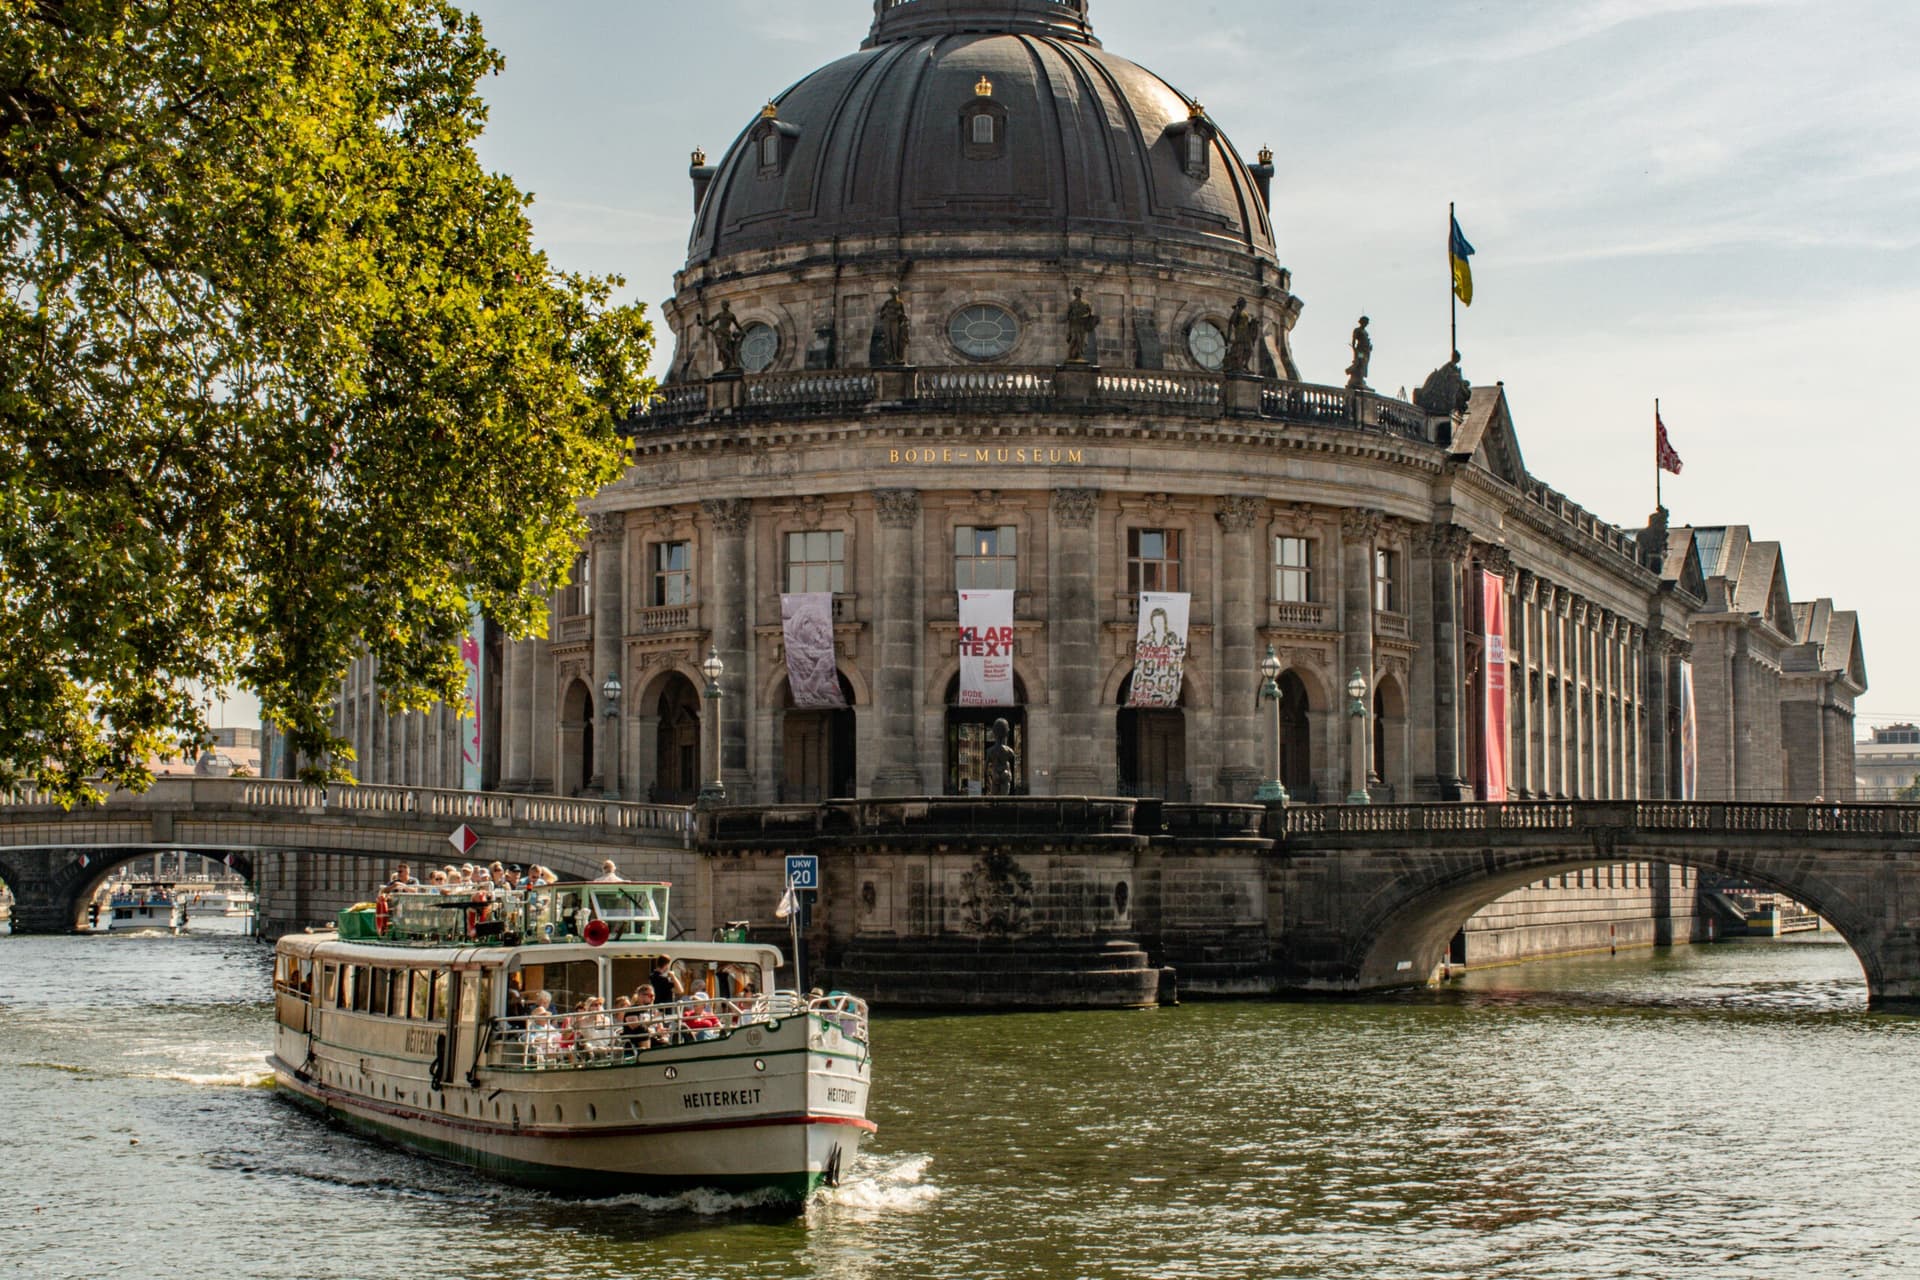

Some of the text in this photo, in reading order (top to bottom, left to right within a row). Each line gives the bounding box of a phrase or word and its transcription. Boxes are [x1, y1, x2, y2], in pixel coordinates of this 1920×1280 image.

[889, 449, 1082, 463] BODE-MUSEUM
[959, 626, 1013, 641] KLAR
[959, 642, 1014, 656] TEXT
[792, 860, 812, 868] UKW
[792, 870, 811, 884] 20
[683, 1089, 761, 1109] HEITERKEIT
